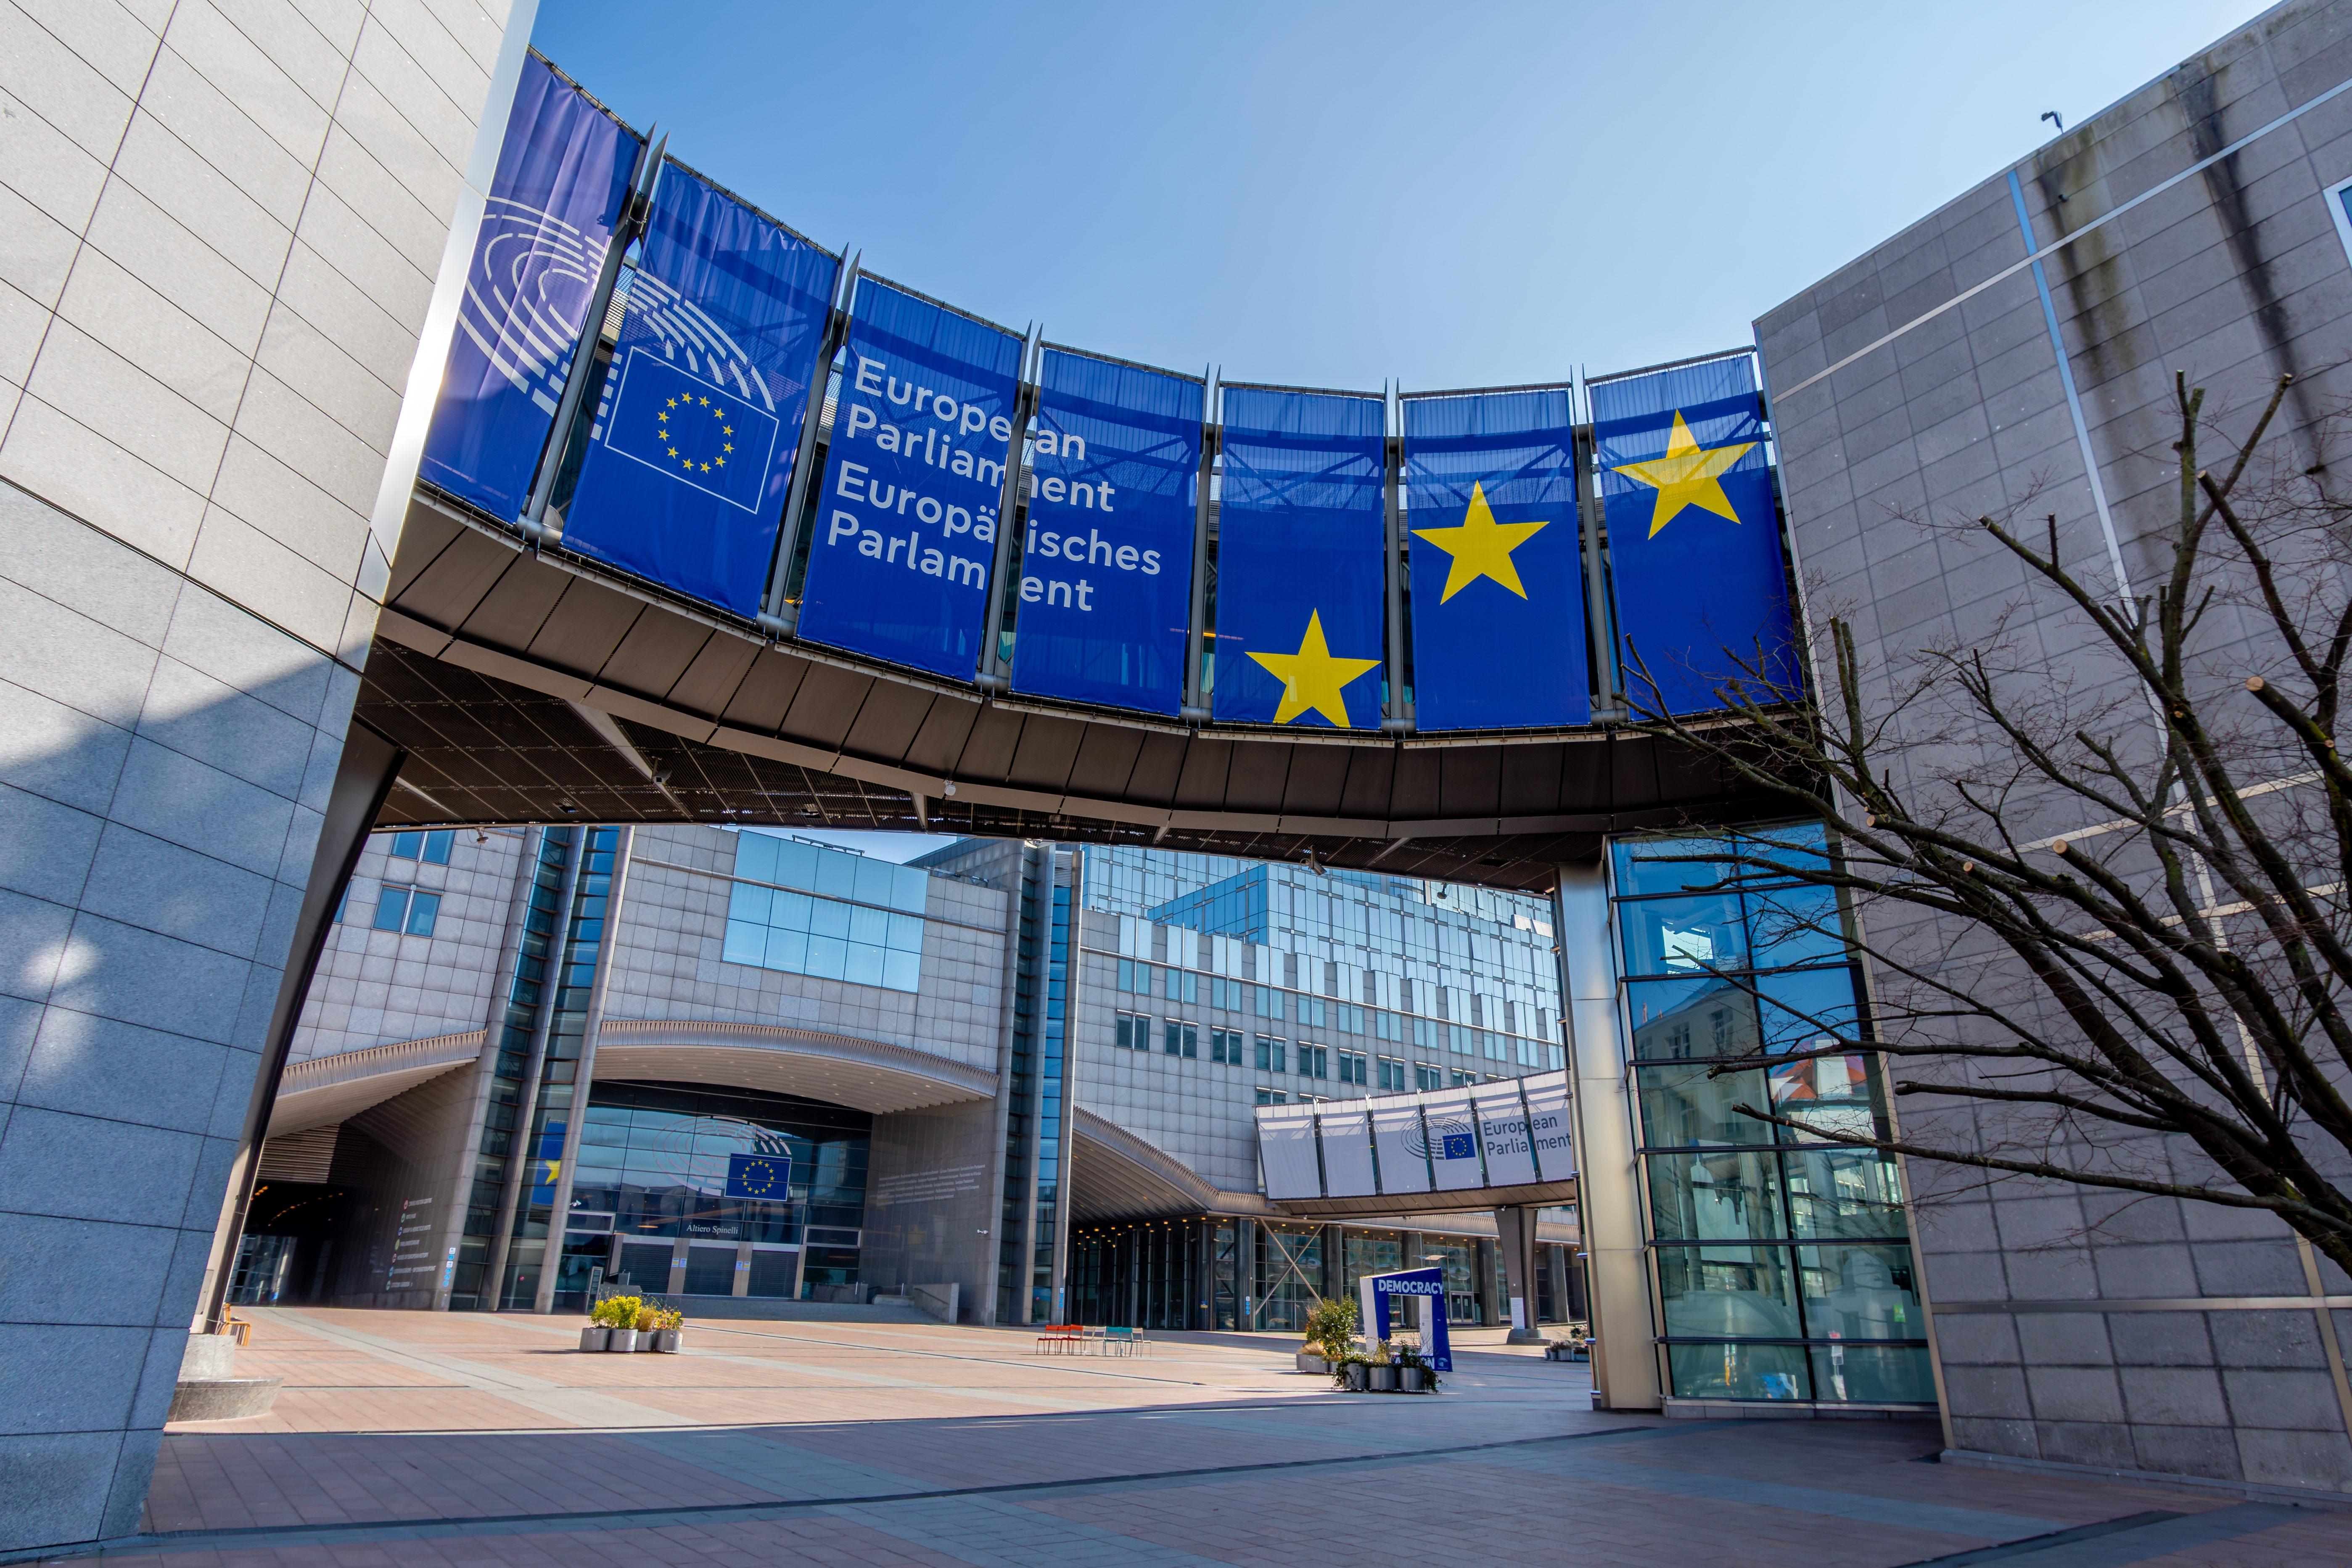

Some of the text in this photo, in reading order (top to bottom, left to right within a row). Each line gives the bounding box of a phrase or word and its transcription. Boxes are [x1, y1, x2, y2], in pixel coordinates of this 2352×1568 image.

[855, 356, 1086, 460] European
[836, 460, 1161, 575] Europäisches
[828, 509, 1094, 611] Parlament
[1483, 1116, 1558, 1136] European
[1487, 1133, 1572, 1156] Parliament
[687, 1224, 738, 1235] Altiero Spinelli
[1379, 1280, 1443, 1294] DEMOCRACY
